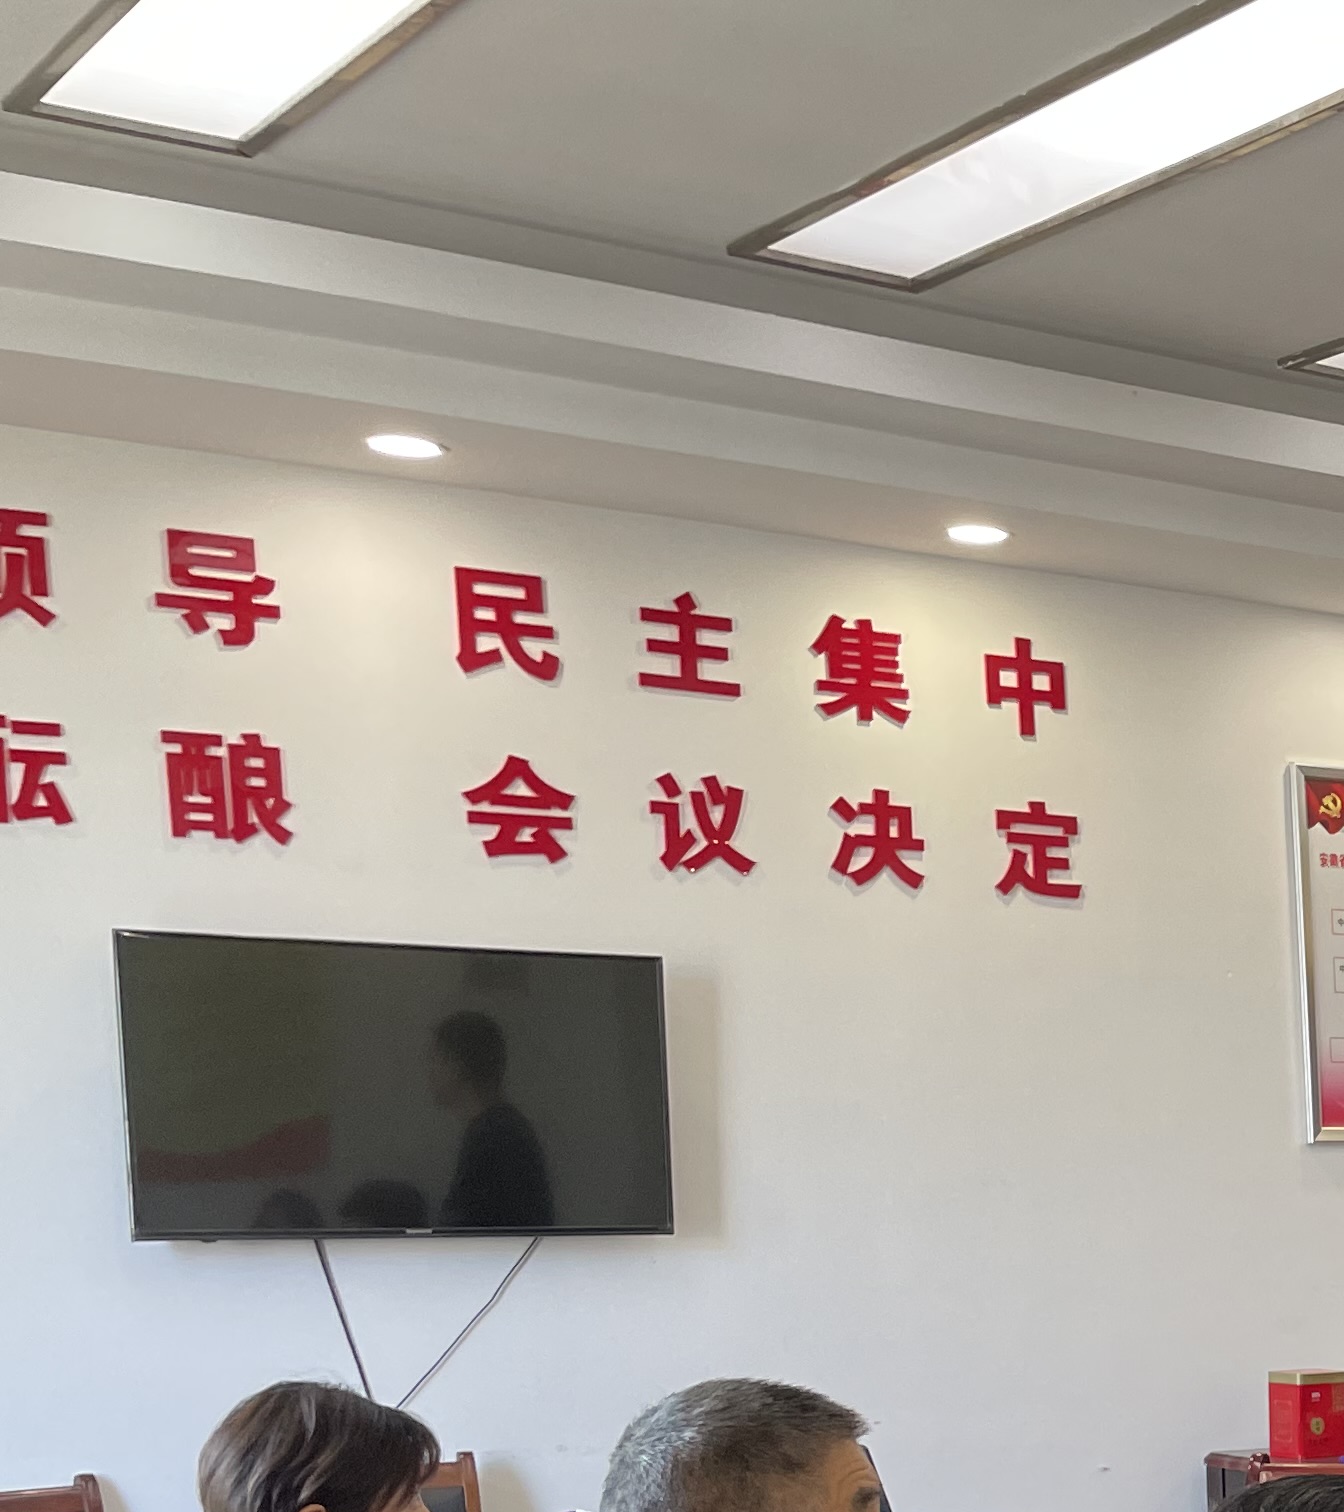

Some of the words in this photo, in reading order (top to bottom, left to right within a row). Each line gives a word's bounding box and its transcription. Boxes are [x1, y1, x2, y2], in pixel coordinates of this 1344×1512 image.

[453, 565, 1069, 739] 民主集中
[462, 755, 1084, 901] 会议决定
